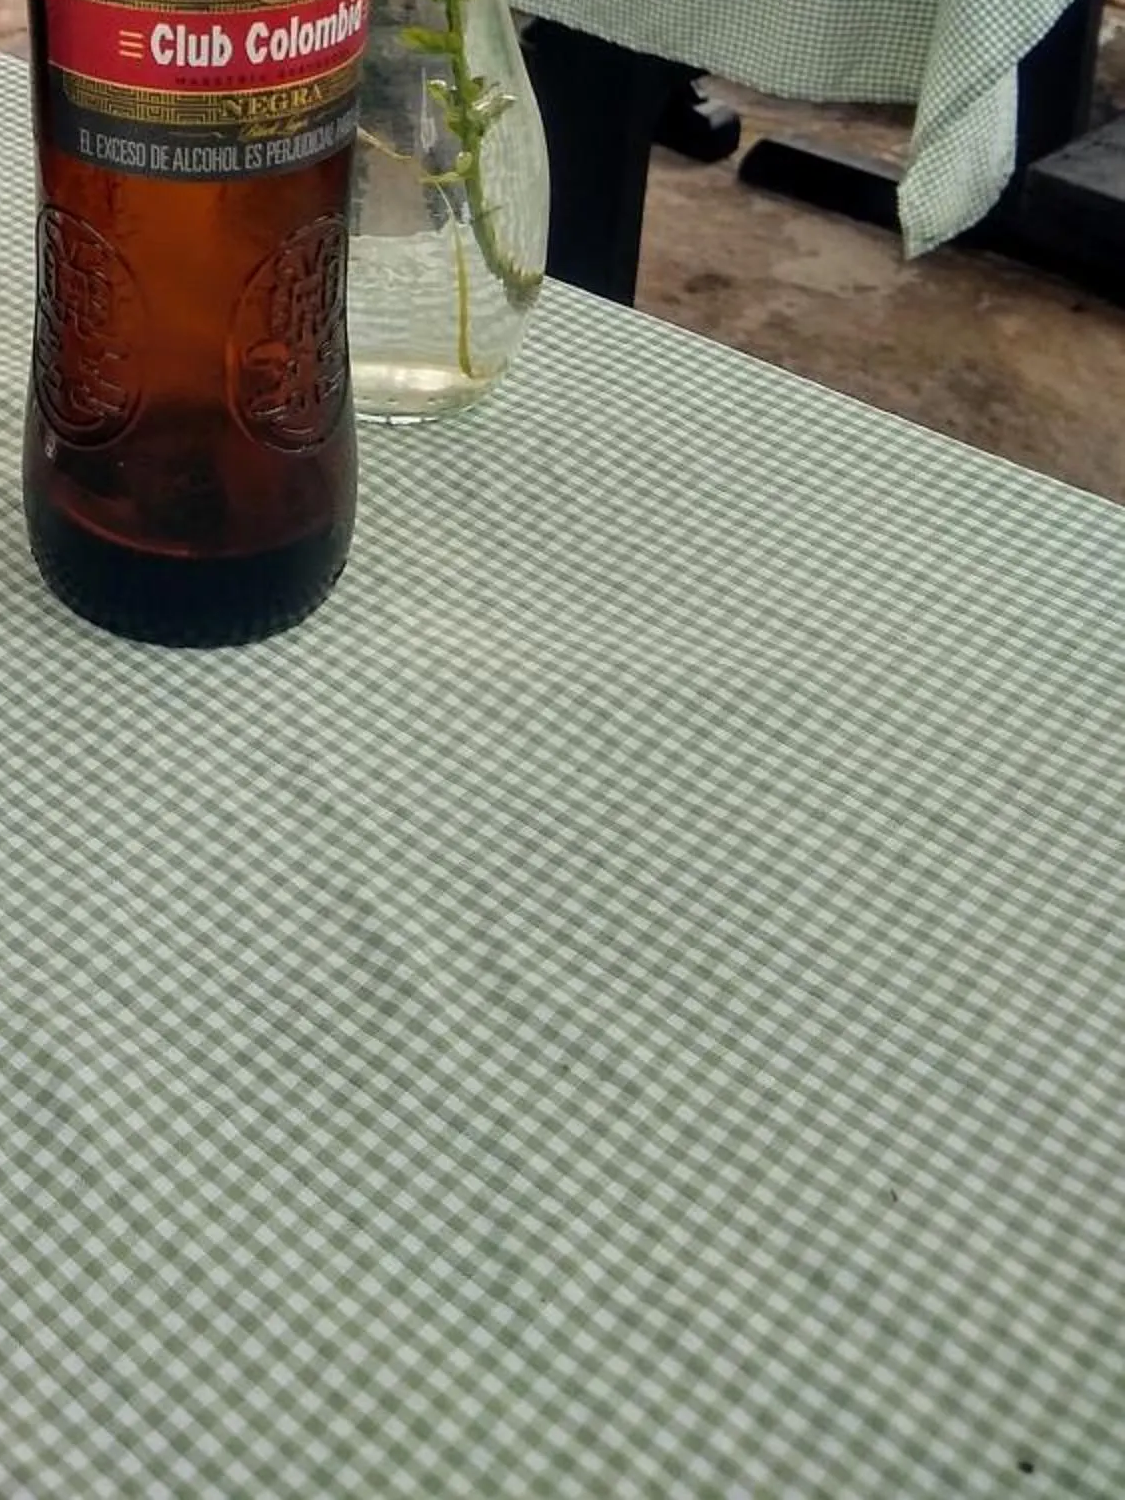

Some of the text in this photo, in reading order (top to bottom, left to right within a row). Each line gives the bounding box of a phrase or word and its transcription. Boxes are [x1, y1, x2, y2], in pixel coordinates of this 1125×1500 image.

[150, 22, 233, 68] Club
[219, 86, 323, 117] NEGRA
[79, 128, 94, 156] EL
[95, 133, 146, 168] EXCESO
[150, 143, 171, 170] DE
[172, 146, 241, 173] ALCOHOL
[244, 142, 263, 169] ES
